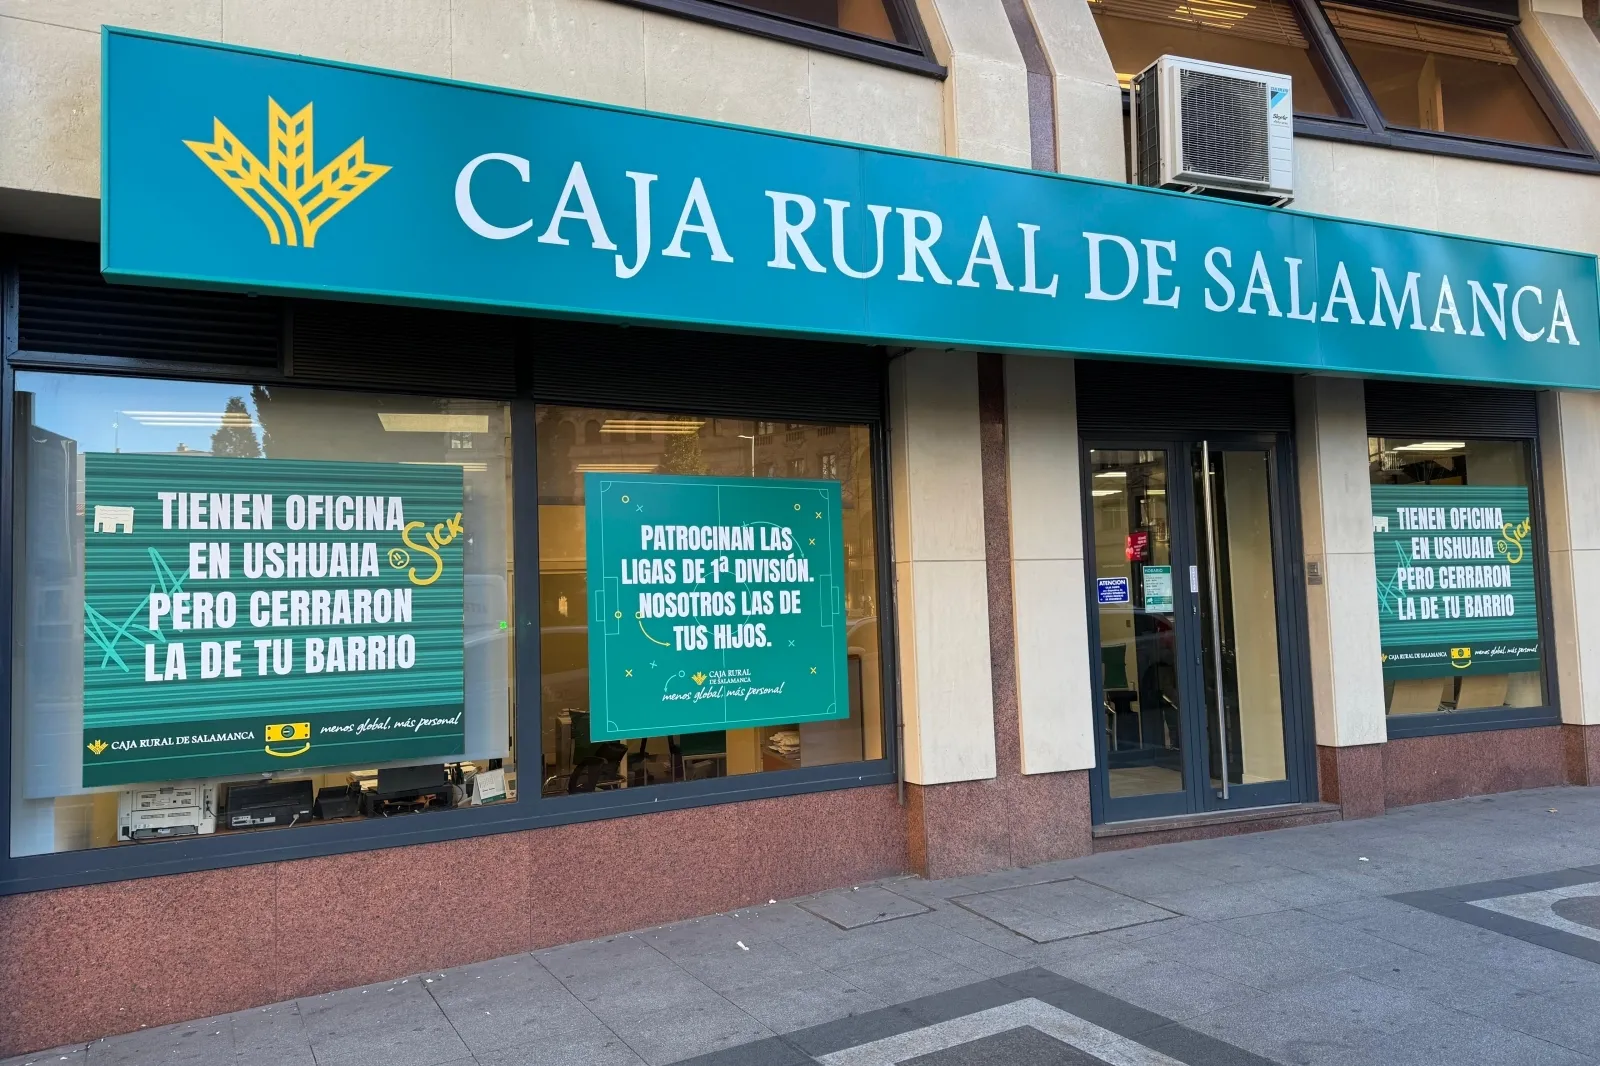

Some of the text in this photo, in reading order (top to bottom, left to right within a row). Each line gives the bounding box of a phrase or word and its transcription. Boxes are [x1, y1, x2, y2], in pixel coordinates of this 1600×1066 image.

[455, 152, 1580, 346] CAJA RURAL DE SALAMANCA
[157, 492, 405, 531] TIENEN OFICINA
[1396, 507, 1504, 530] TIENEN OFICINA
[641, 524, 793, 551] PATROCINAN LAS
[1411, 536, 1495, 560] EN USHUAIA
[189, 542, 380, 579] EN USHUAIA
[621, 558, 676, 585] LIGAS
[682, 558, 706, 584] DE
[735, 553, 815, 583] DIVISIÓN.
[1397, 565, 1511, 590] PERO CERRARON
[149, 588, 413, 630] PERO CERRARON
[639, 590, 801, 618] NOSOTROS LAS DE
[1398, 594, 1515, 621] LA DE TU BARRIO
[673, 623, 772, 651] TUS HIJOS.
[145, 634, 416, 682] LA DE TU BARRIO
[1388, 653, 1400, 661] CAJA
[1400, 652, 1414, 660] RURAL
[1420, 652, 1447, 660] SALAMANCA
[709, 669, 751, 679] CAJA RURAL
[717, 677, 752, 685] SALAMANCA
[662, 691, 692, 701] menos
[726, 687, 745, 697] más
[744, 682, 785, 701] personal
[320, 724, 354, 734] menos
[394, 717, 416, 728] más
[415, 712, 462, 732] personal
[111, 731, 255, 751] CAJA RURAL DE SALAMANCA
